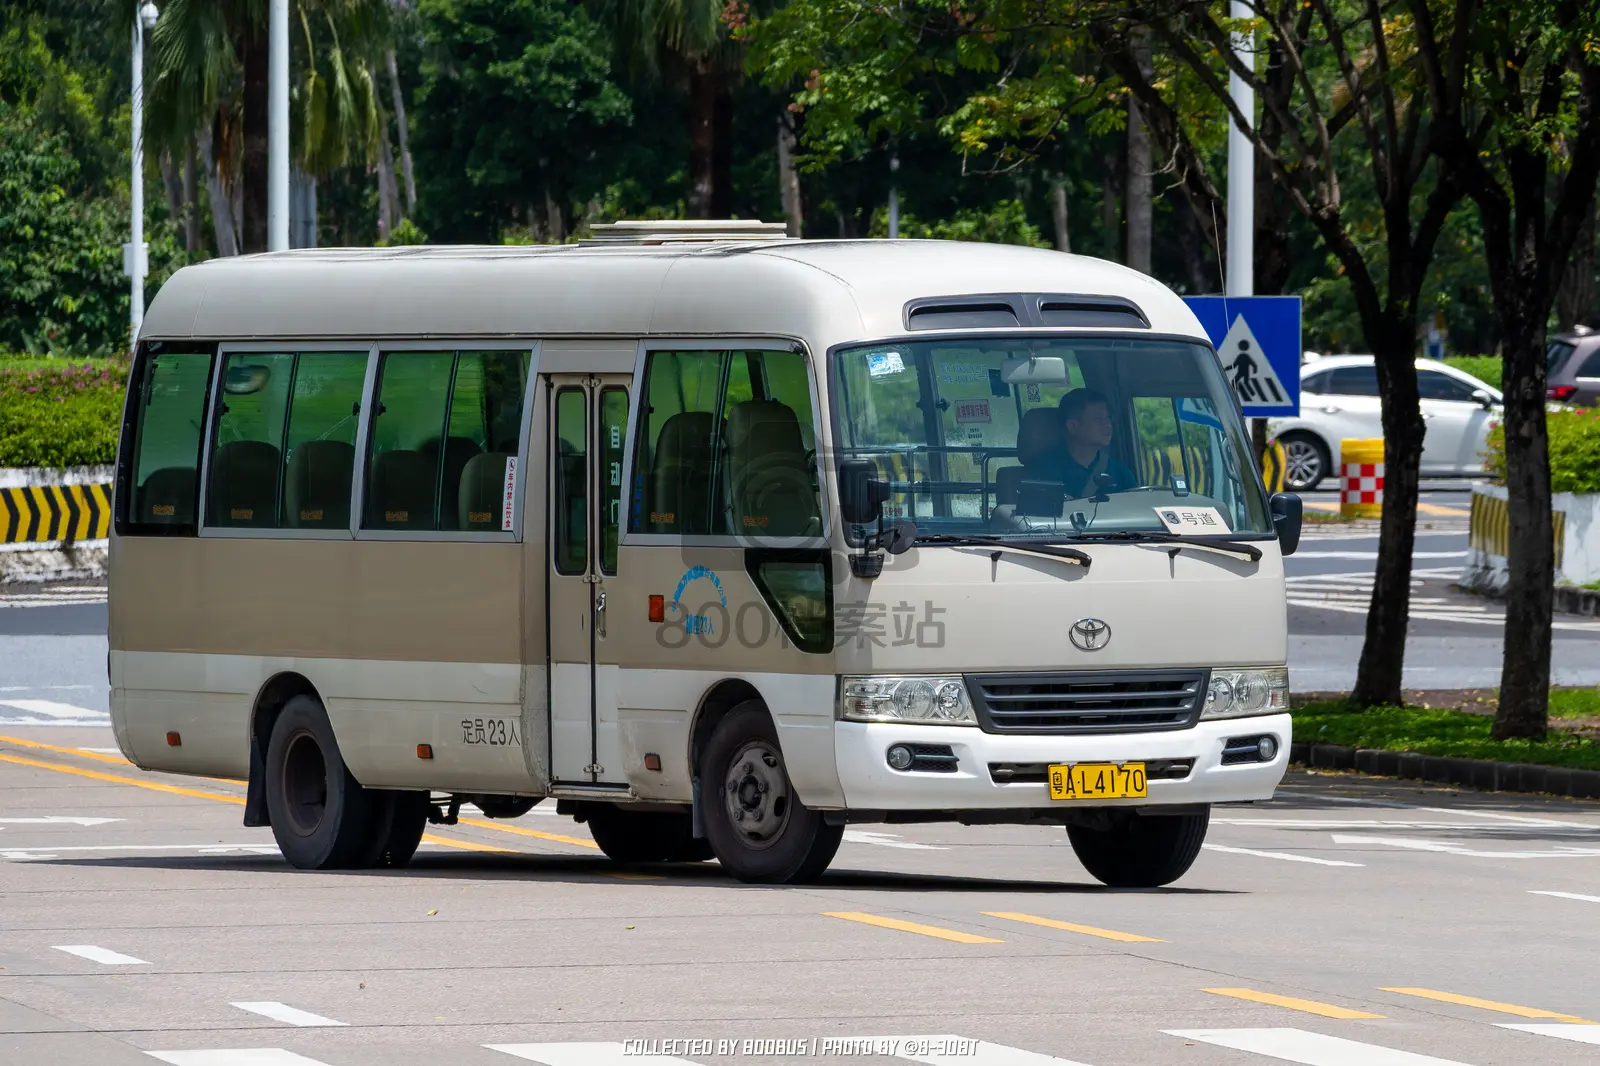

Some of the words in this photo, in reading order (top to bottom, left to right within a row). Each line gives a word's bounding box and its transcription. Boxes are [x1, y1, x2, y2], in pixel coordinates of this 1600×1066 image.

[504, 472, 515, 529] 车内禁止饮食
[1164, 511, 1218, 526] 3号道
[461, 718, 521, 746] 定员23人
